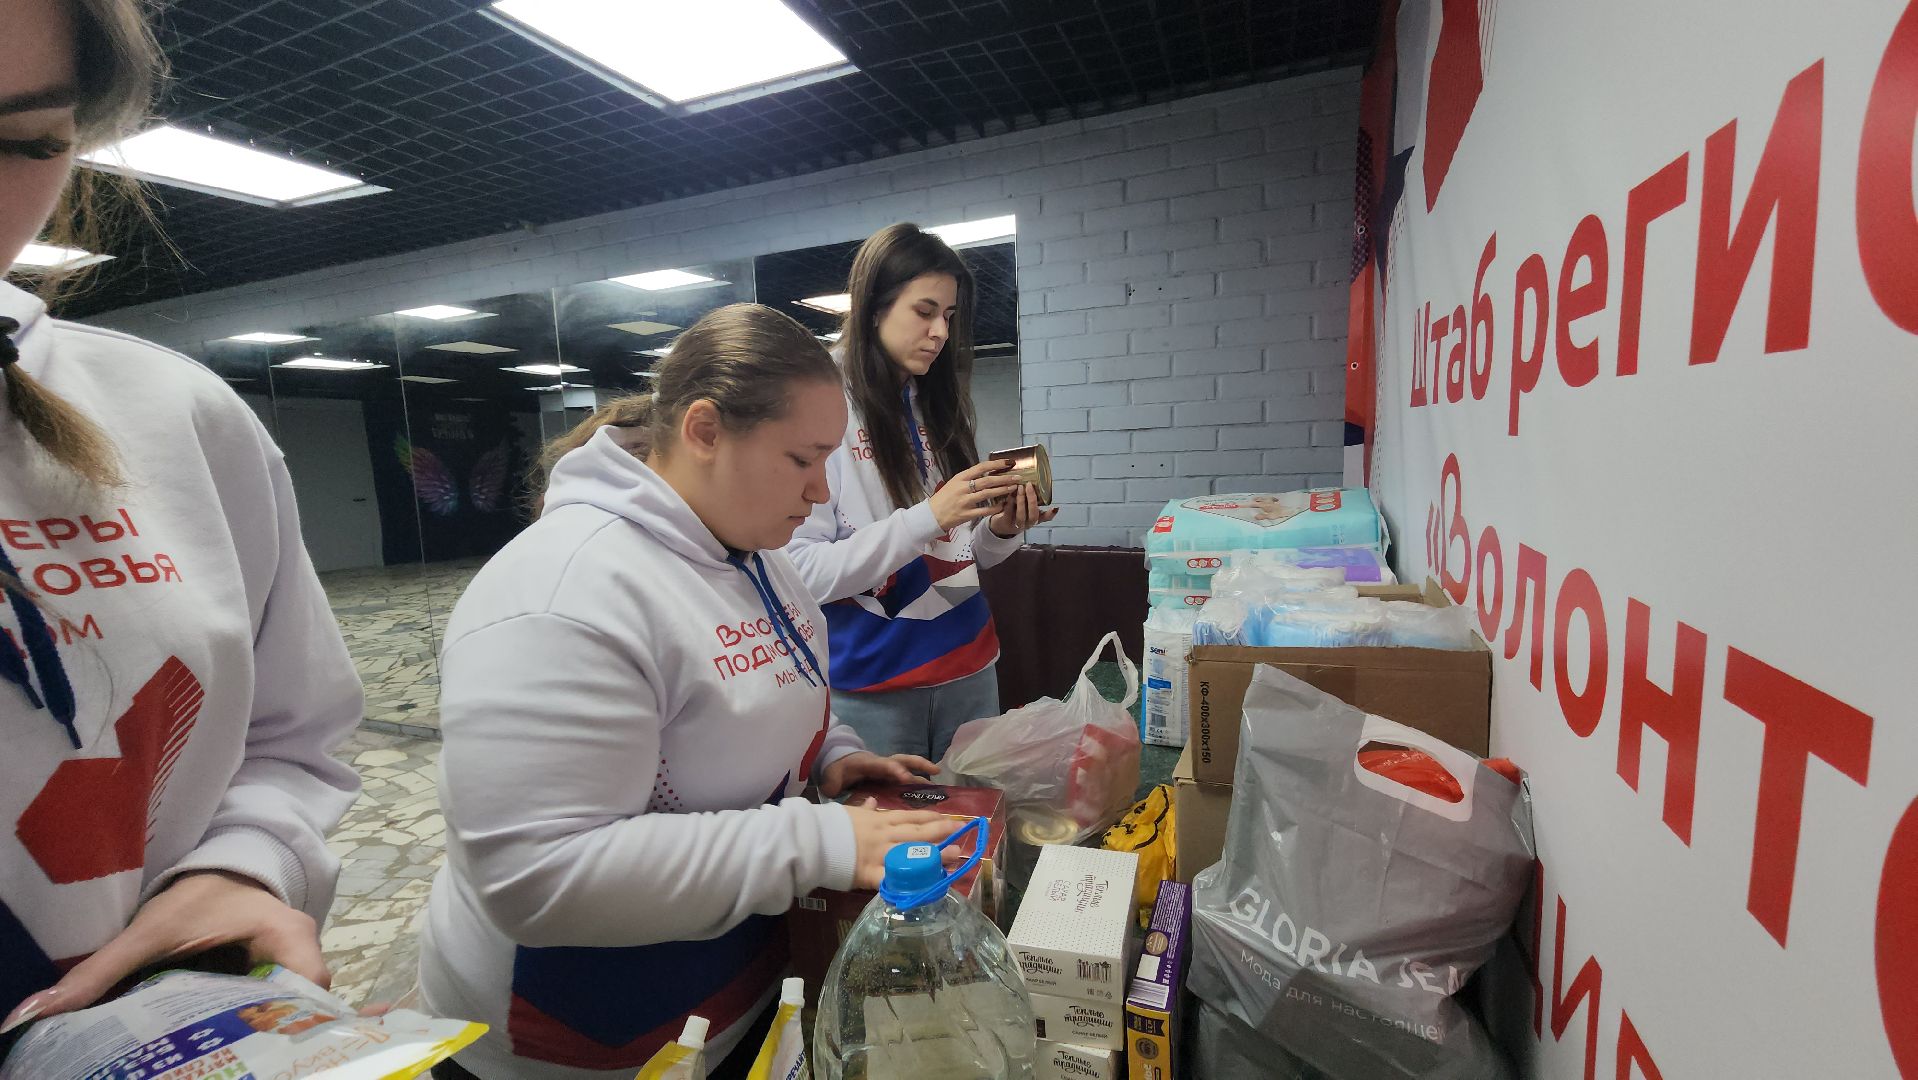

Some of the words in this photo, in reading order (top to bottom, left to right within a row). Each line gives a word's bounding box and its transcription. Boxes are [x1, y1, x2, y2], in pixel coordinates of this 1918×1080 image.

[1410, 230, 1496, 409] Штаб
[0, 553, 183, 603] ОВЬЯ
[1230, 887, 1380, 984] GLORIA
[1019, 951, 1053, 965] Теплые
[1241, 949, 1281, 991] Мода
[1286, 985, 1322, 1006] для
[1331, 1001, 1445, 1043] настояще
[1064, 1013, 1113, 1028] традиции
[1069, 1005, 1105, 1019] Теплые
[1053, 1058, 1100, 1079] традиции
[1057, 1050, 1092, 1069] Теплые
